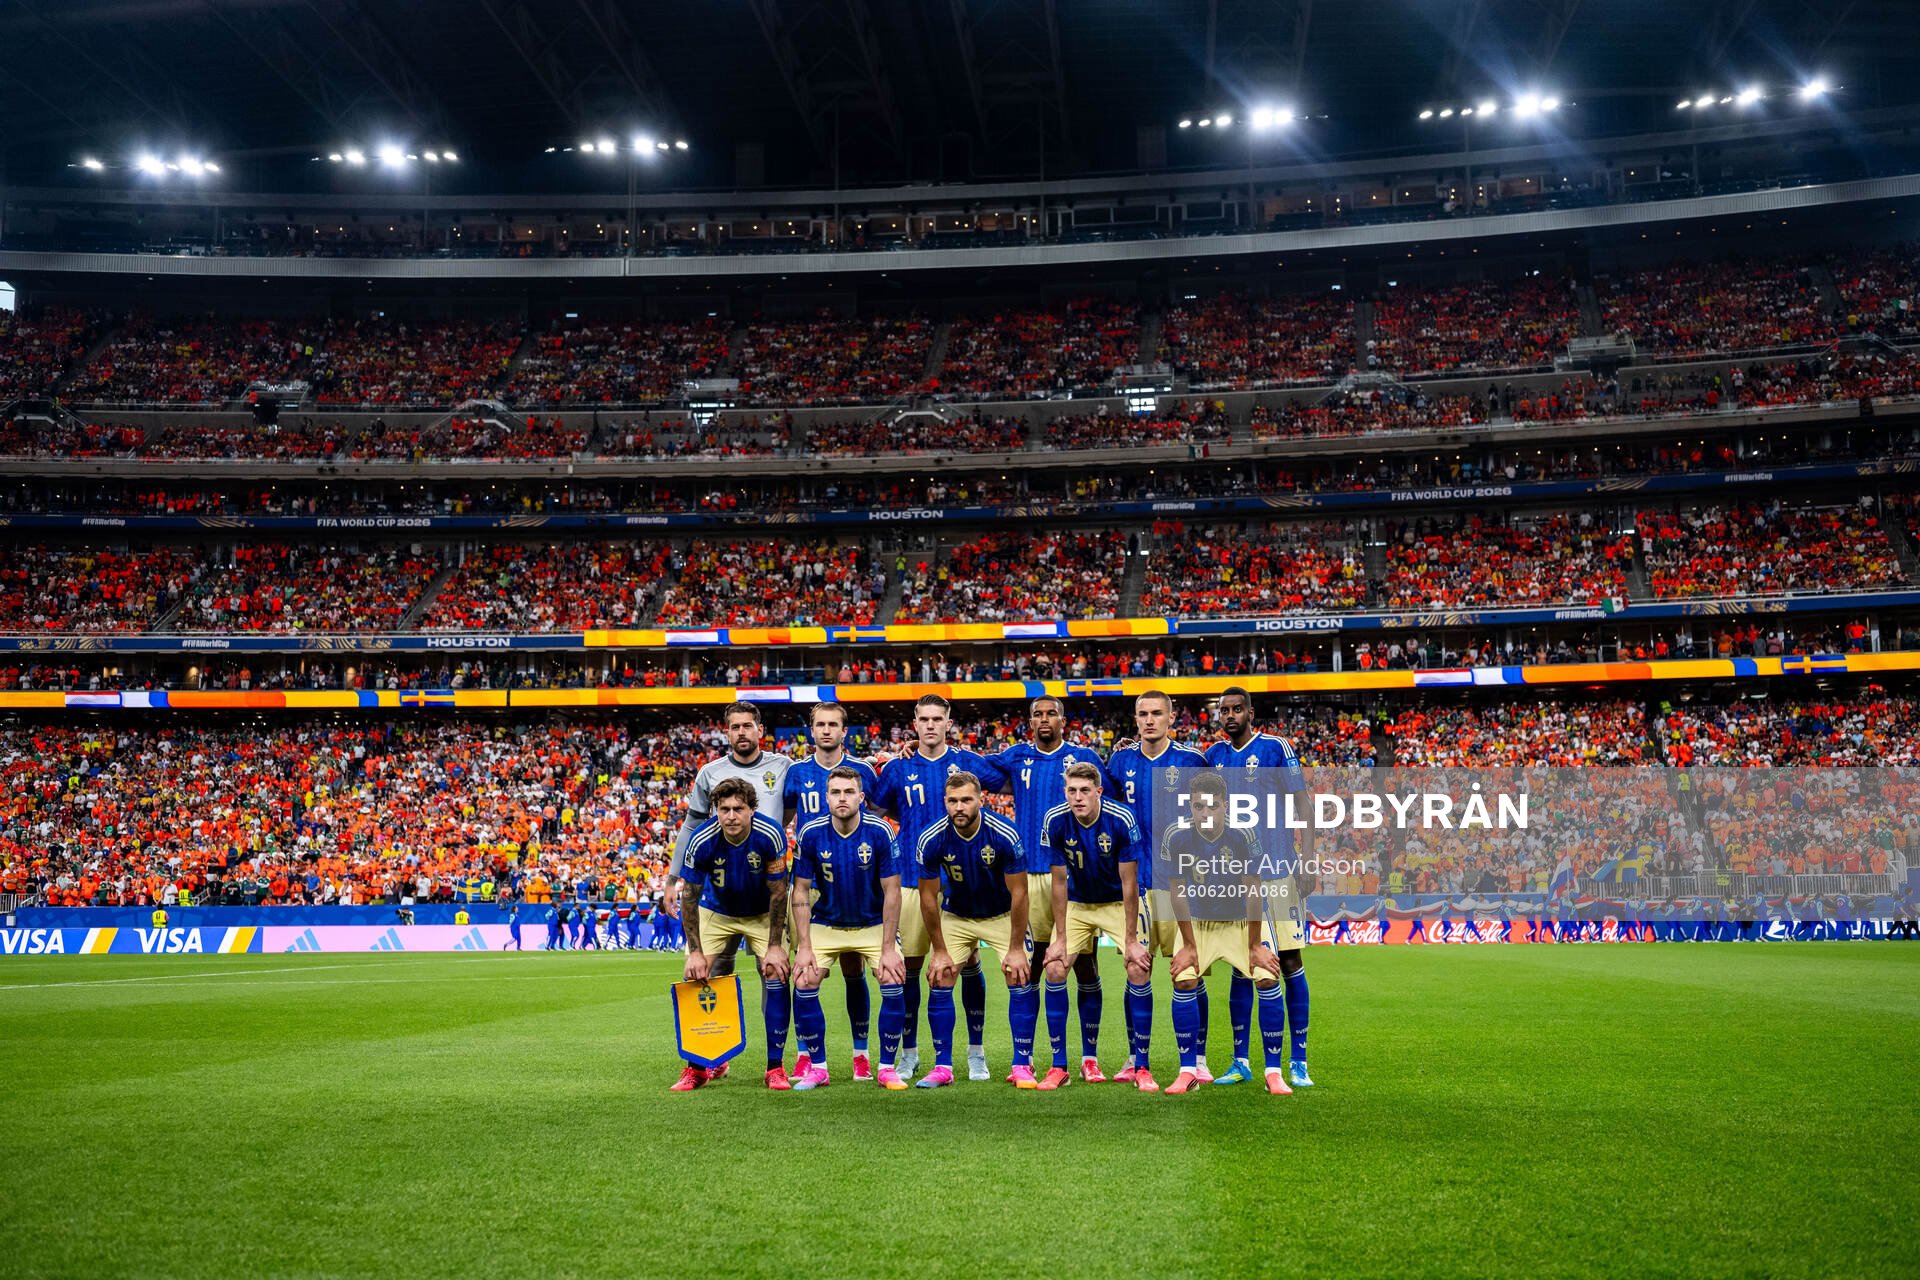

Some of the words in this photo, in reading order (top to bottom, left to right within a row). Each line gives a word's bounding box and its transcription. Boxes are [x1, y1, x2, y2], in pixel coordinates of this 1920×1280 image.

[1391, 492, 1413, 501] FIFA
[1415, 490, 1451, 499] WORLD
[1453, 489, 1474, 498] CUP
[1475, 487, 1512, 496] 2026
[317, 518, 338, 527] FIFA
[340, 518, 375, 527] WORLD
[376, 518, 396, 527] CUP
[397, 518, 431, 527] 2026
[868, 510, 944, 520] HOUSTON
[1255, 618, 1343, 630] HOUSTON
[182, 639, 230, 648] #FIFAWorldCup
[427, 637, 510, 647] HOUSTON
[1021, 768, 1032, 790] 4
[801, 791, 820, 814] 10
[904, 783, 926, 807] 17
[1125, 780, 1136, 804] 2
[713, 868, 725, 888] 3
[821, 862, 834, 883] 5
[1289, 906, 1300, 928] 9
[0, 928, 65, 954] VISA
[133, 928, 204, 953] VISA
